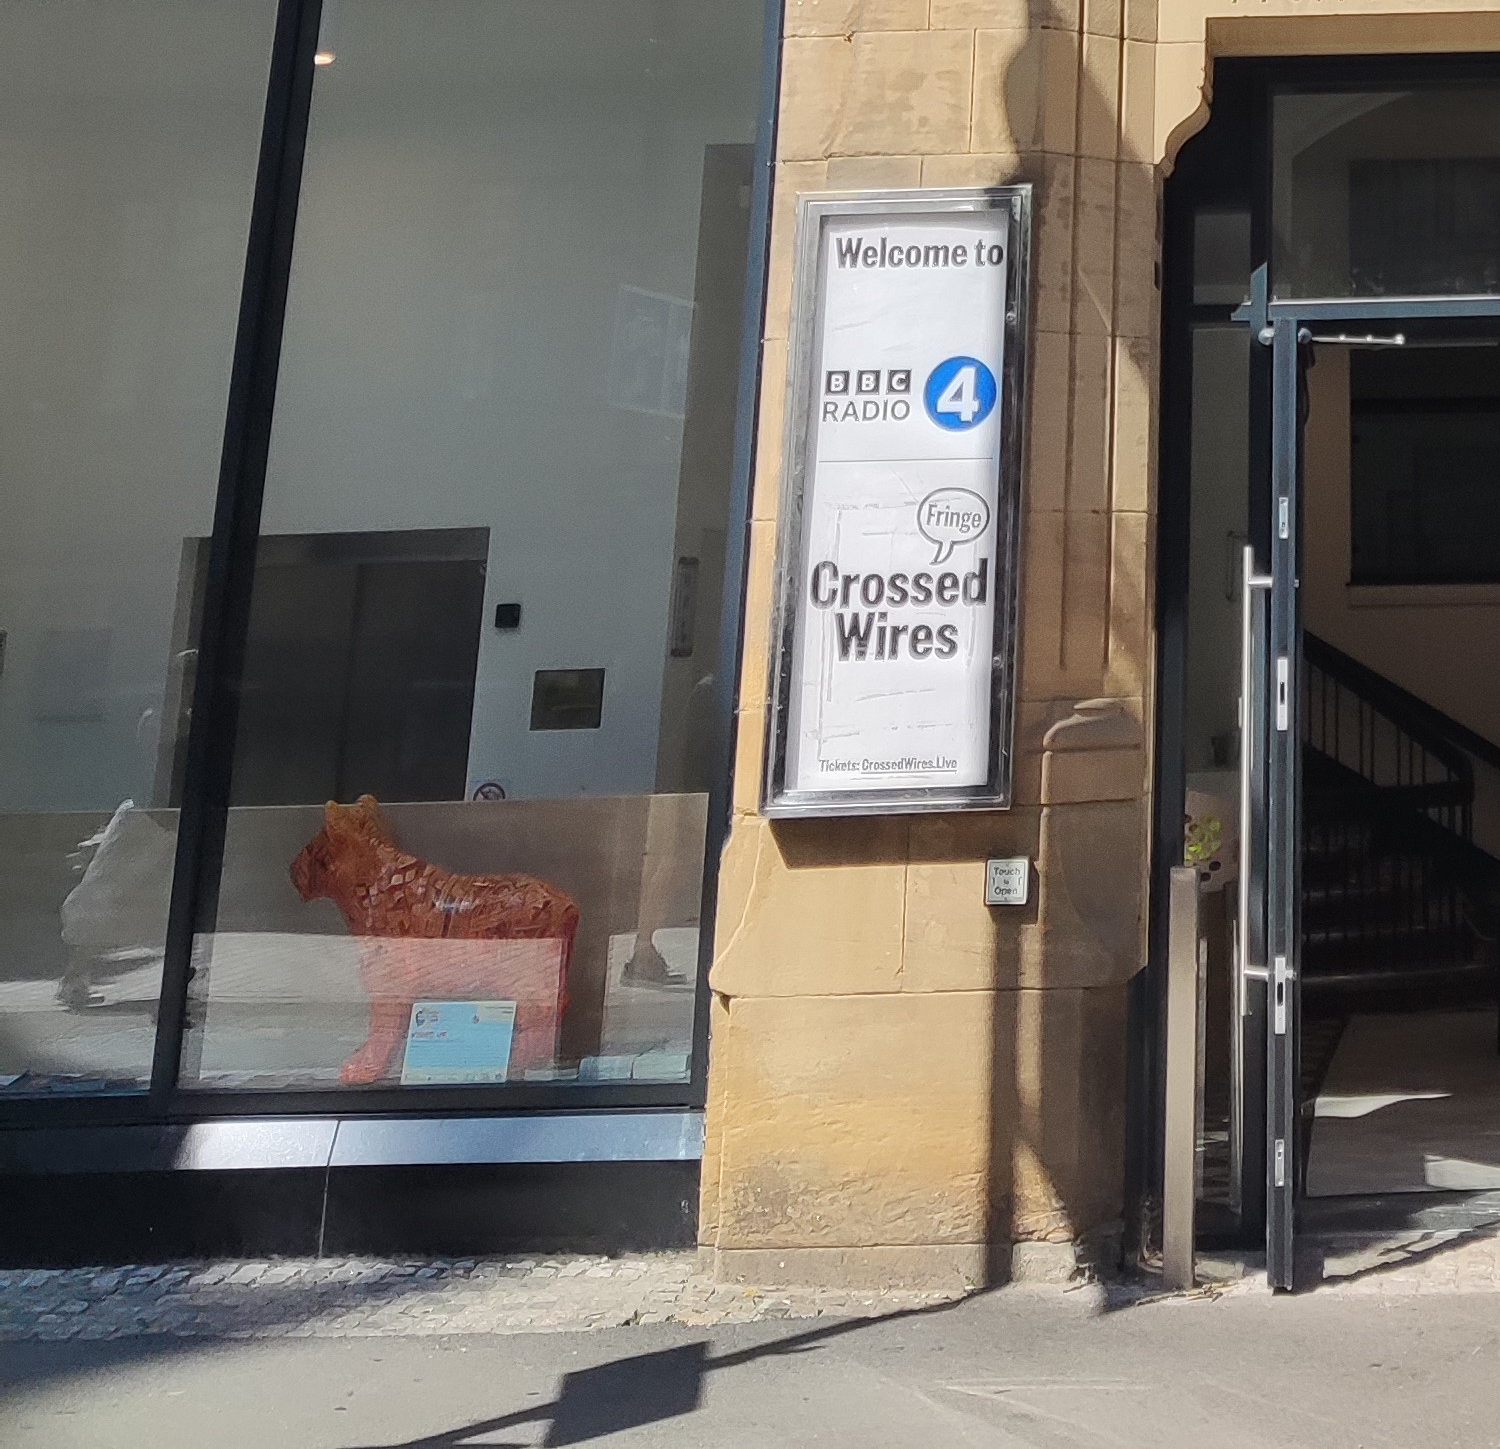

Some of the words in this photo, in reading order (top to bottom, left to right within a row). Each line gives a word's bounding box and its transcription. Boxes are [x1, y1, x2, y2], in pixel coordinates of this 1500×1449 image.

[835, 236, 968, 269] Welcome
[974, 239, 1004, 267] to
[822, 399, 911, 423] RADIO
[936, 365, 981, 423] 4
[825, 369, 912, 396] BBC
[925, 502, 982, 534] Fringe
[810, 557, 988, 610] Crossed
[834, 610, 959, 662] Wires
[819, 759, 860, 772] Tickets:
[862, 754, 958, 771] CrossedWires.Live
[994, 886, 1018, 896] Open
